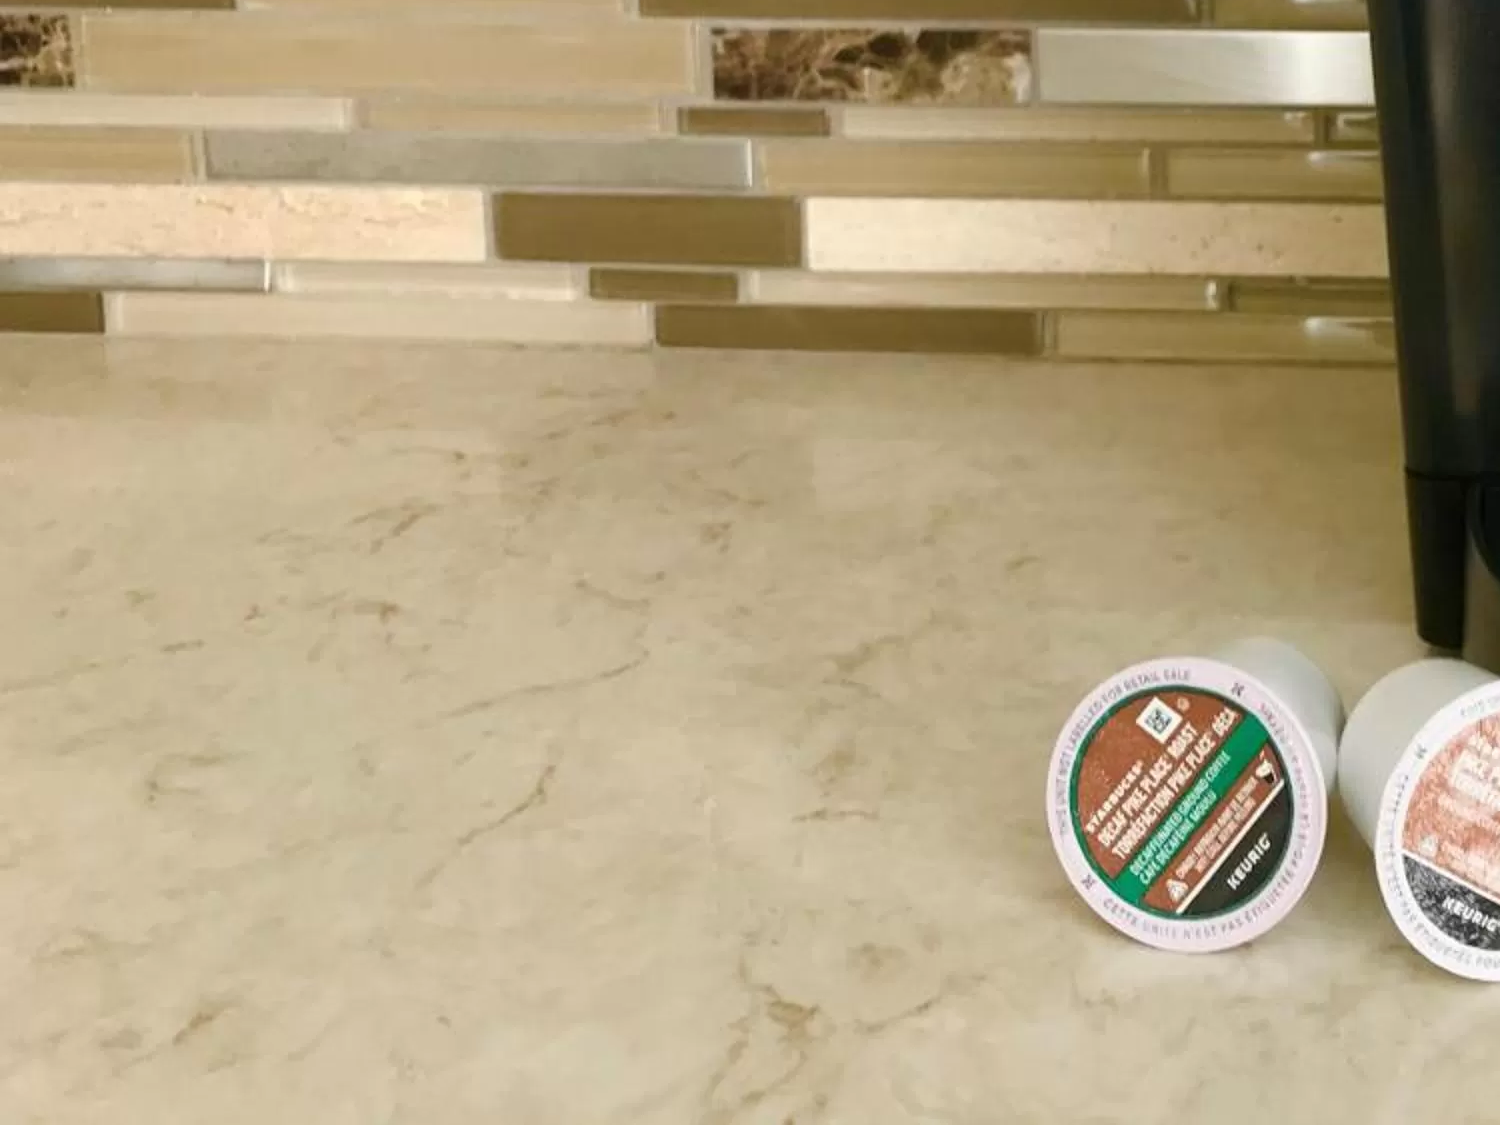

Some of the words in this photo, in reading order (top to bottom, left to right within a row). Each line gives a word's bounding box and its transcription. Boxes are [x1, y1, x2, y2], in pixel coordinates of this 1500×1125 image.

[1097, 810, 1131, 848] DECAF
[1121, 787, 1148, 817] PIKE
[1139, 756, 1173, 794] PLACE
[1227, 833, 1272, 890] KEURIG
[1442, 897, 1498, 933] KEURIG
